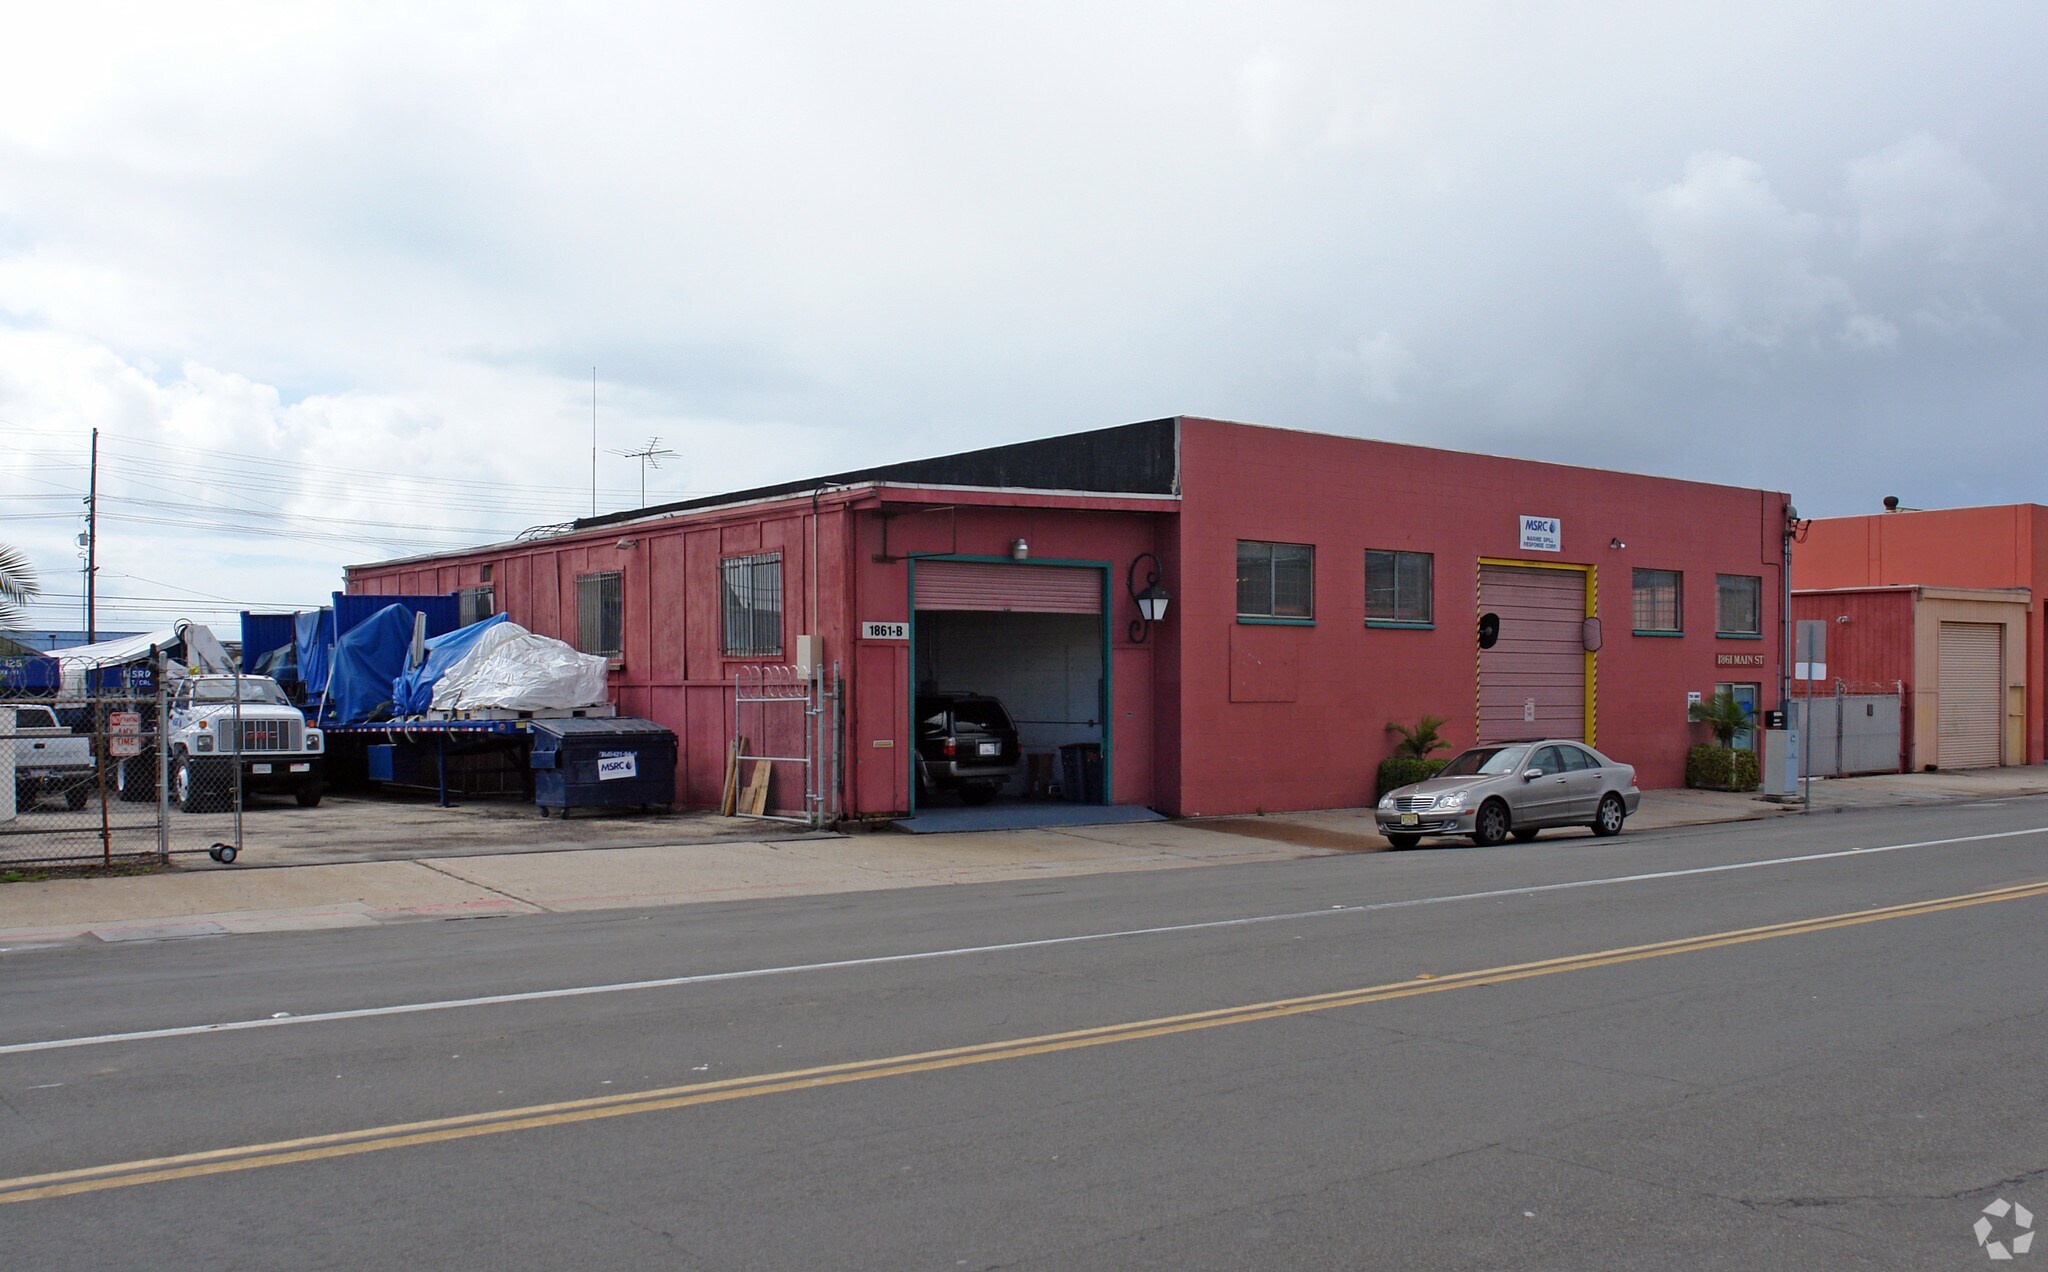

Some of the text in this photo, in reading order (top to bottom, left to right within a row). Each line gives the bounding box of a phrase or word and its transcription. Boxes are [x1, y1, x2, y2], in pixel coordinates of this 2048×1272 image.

[1525, 519, 1548, 532] MSRC
[869, 625, 903, 636] 1861-B
[1718, 655, 1764, 664] 1861 MAIN ST
[246, 730, 278, 740] GMC
[117, 737, 135, 746] TIME
[601, 762, 624, 772] MSRC
